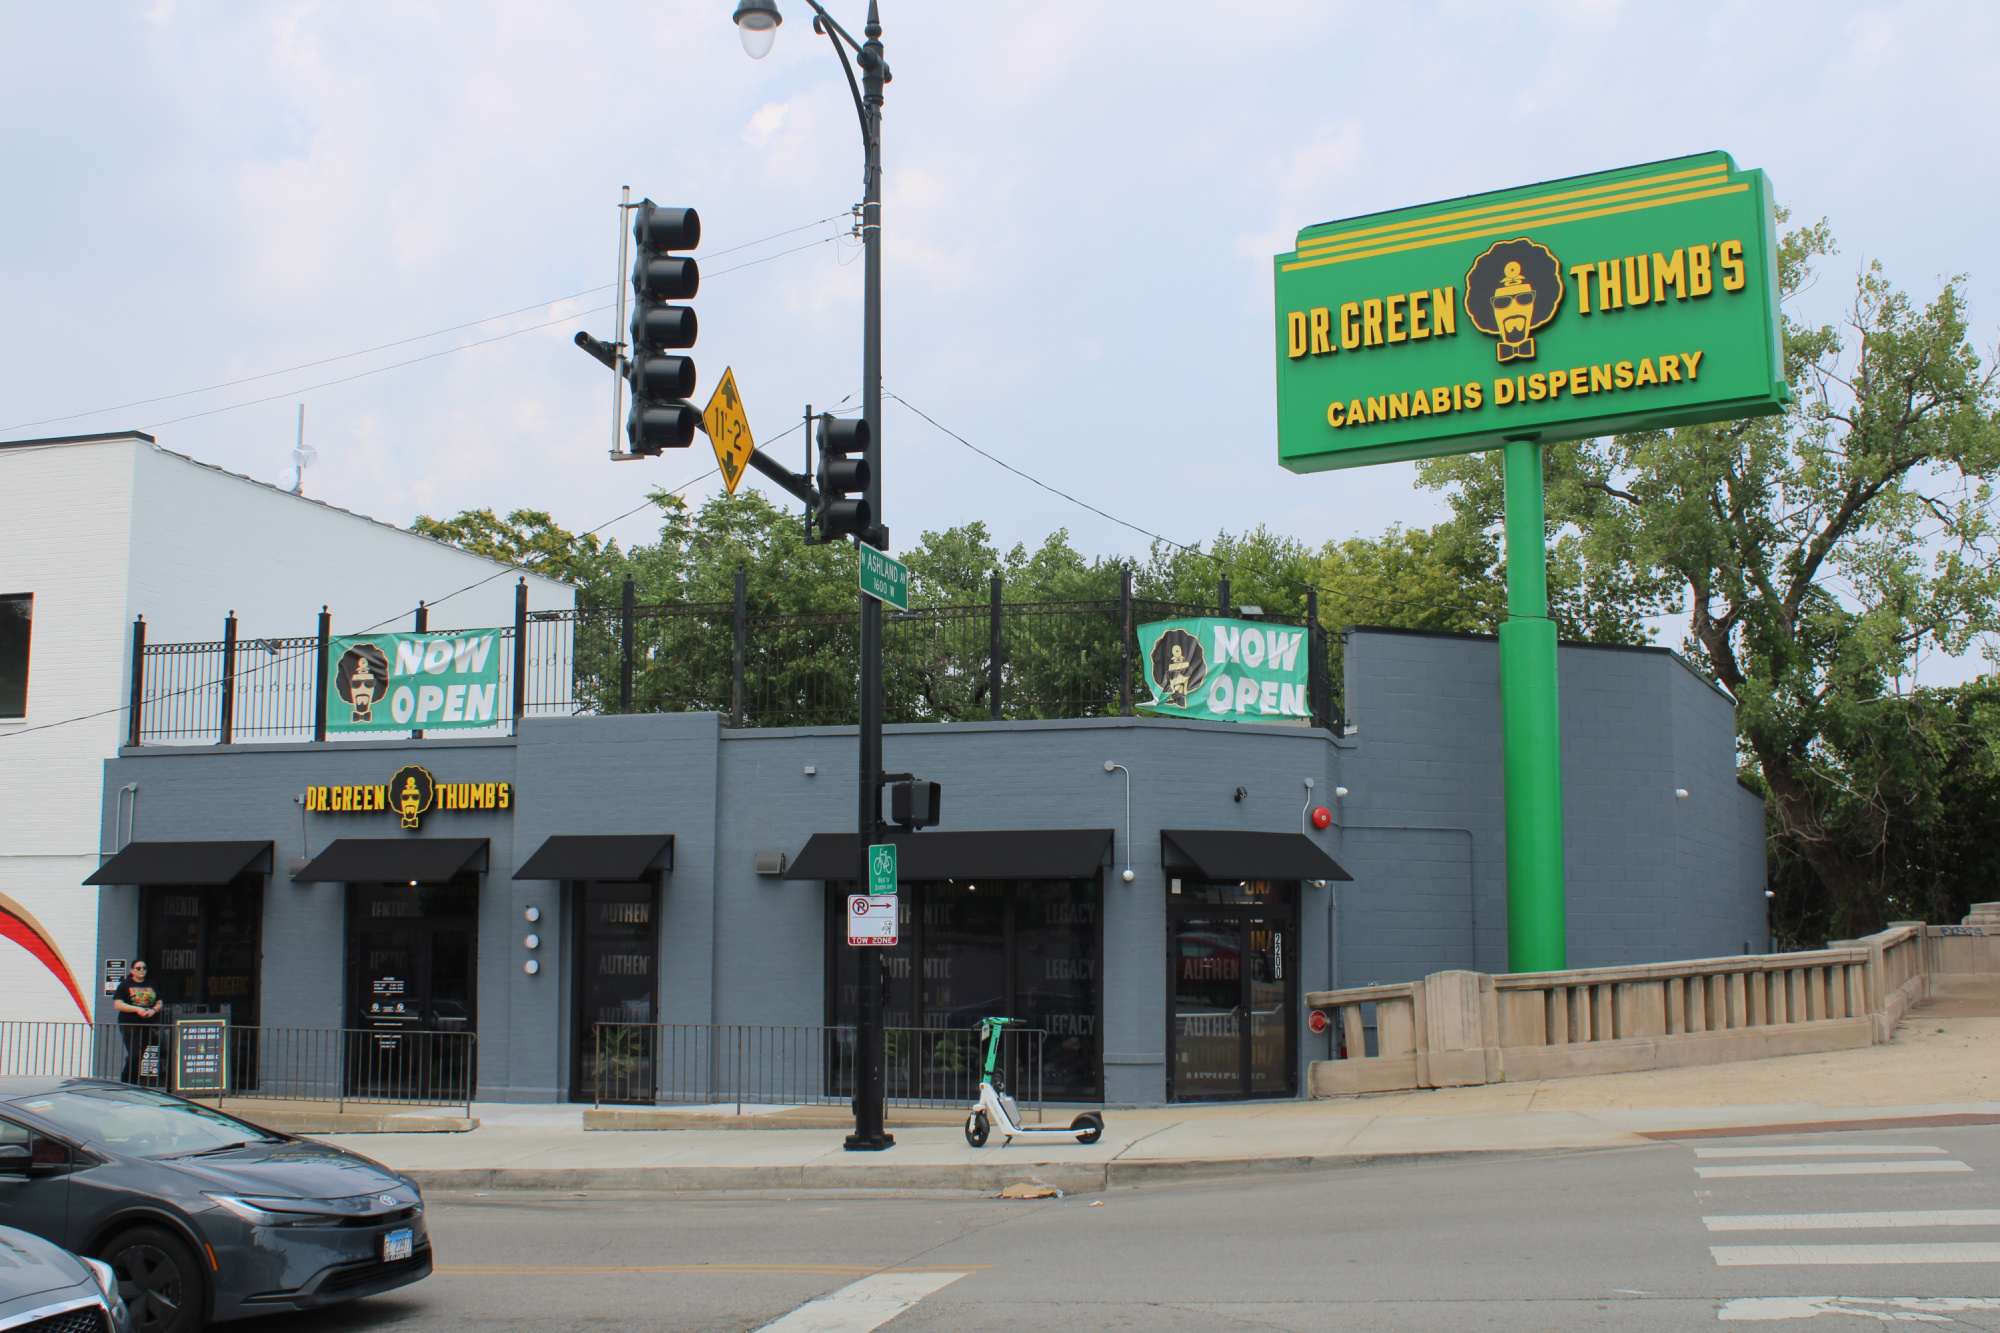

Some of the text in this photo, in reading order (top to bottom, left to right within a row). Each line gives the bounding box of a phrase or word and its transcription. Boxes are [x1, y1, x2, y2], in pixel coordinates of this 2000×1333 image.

[1569, 239, 1746, 315] THUMB'S
[1327, 351, 1704, 429] CANNABIS DISPENSARY
[861, 552, 906, 584] N ASHLAND AV
[873, 578, 895, 598] 1600 W
[393, 636, 494, 676] NOW
[1213, 625, 1303, 671] NOW
[391, 684, 497, 724] OPEN
[1206, 674, 1308, 717] OPEN
[435, 782, 509, 809] THUMB'S
[1046, 903, 1096, 924] LEGACY
[1046, 958, 1096, 979] LEGACY
